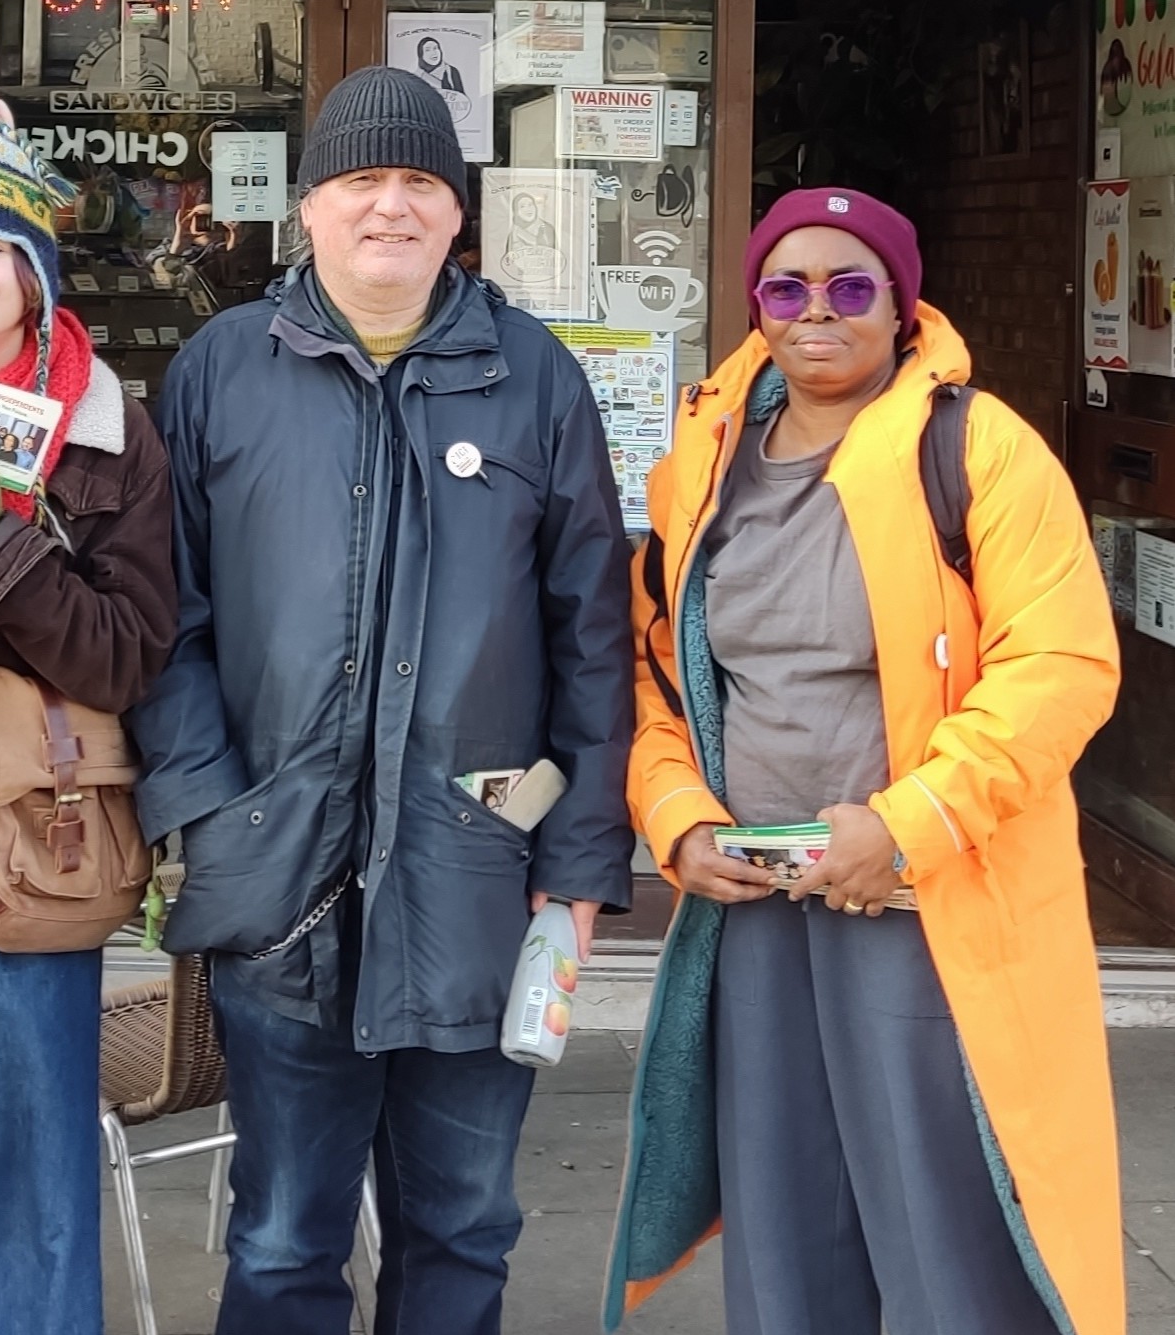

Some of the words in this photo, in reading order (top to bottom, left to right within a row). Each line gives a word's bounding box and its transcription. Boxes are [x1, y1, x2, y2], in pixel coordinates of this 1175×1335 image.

[53, 92, 234, 111] SANDWICHES
[571, 91, 653, 107] WARNING
[607, 270, 641, 284] FREE
[639, 286, 657, 300] WI
[661, 286, 674, 301] FI
